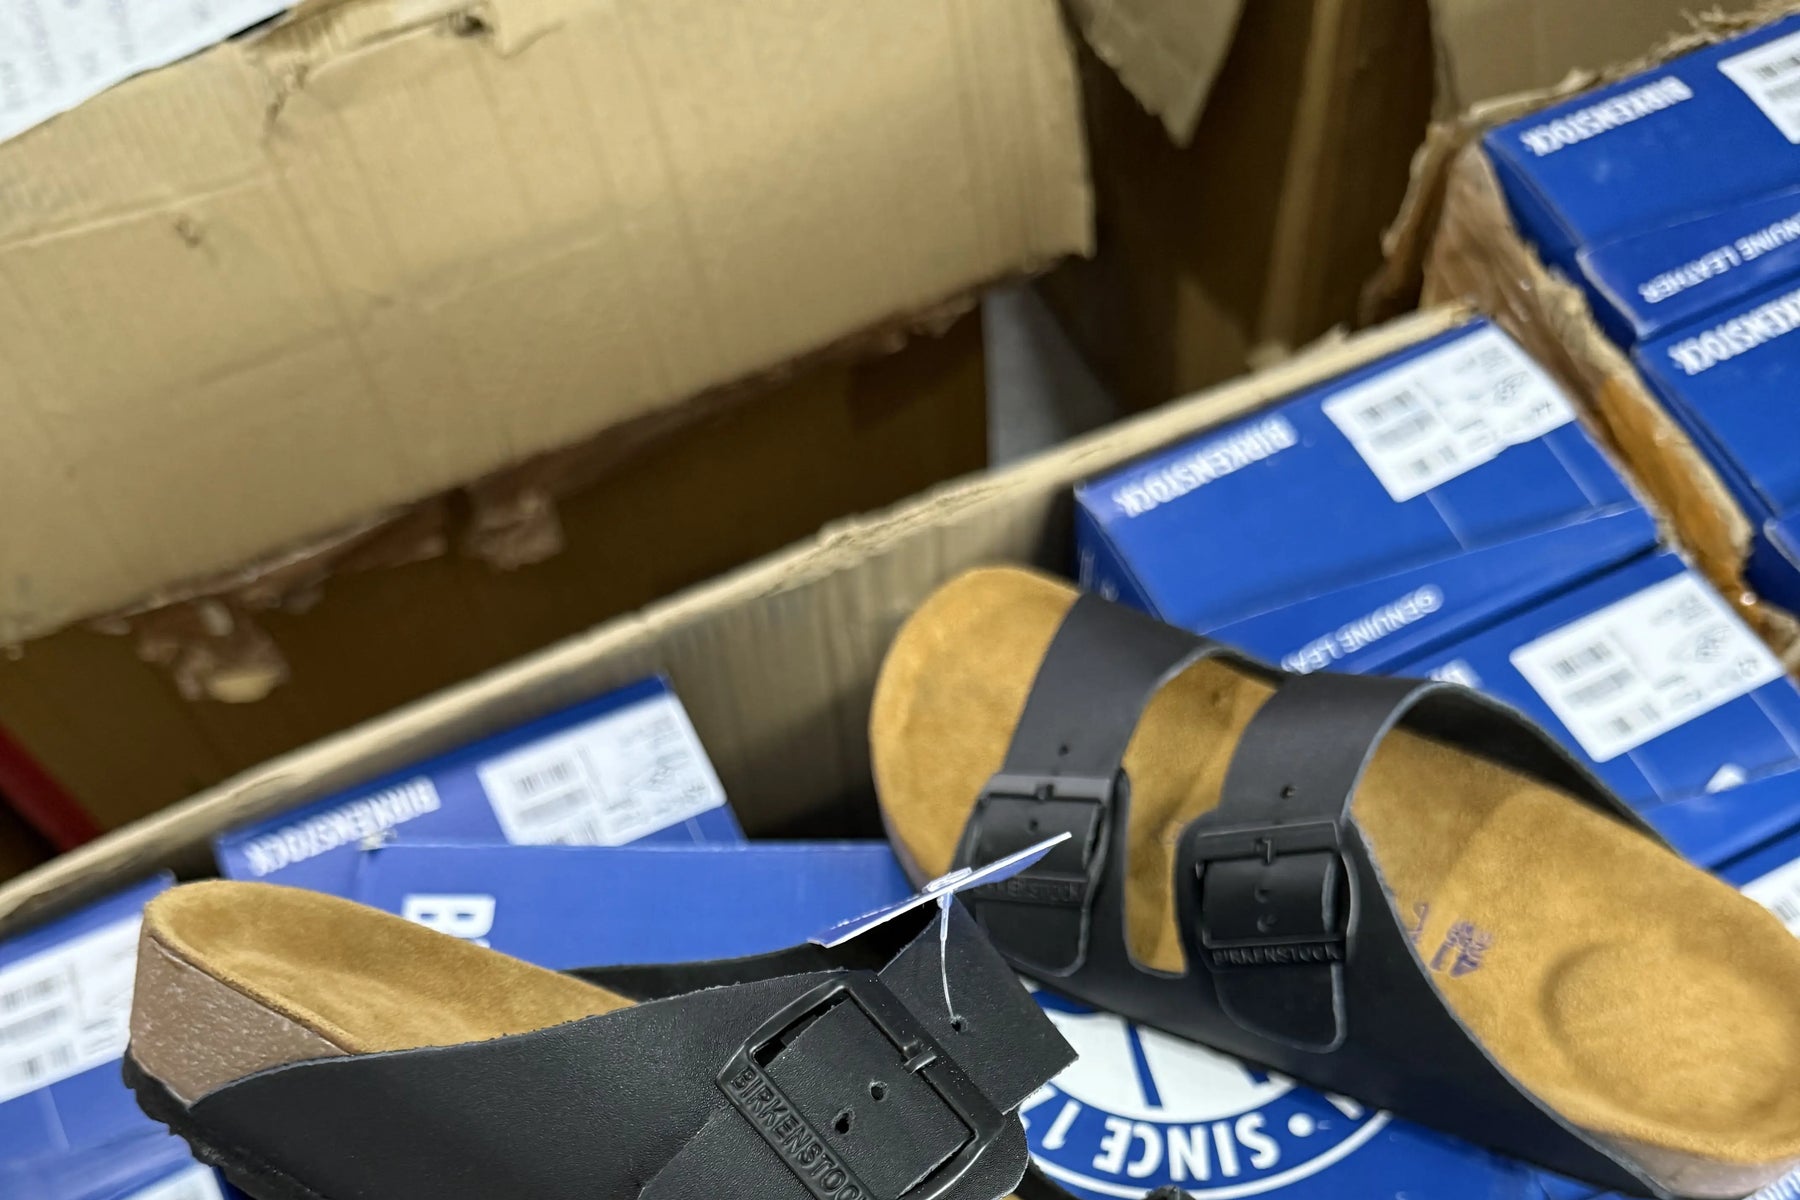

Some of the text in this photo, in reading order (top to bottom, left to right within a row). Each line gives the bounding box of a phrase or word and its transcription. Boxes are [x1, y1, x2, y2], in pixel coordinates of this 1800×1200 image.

[1520, 76, 1694, 156] BIRKENSTOCK
[1639, 246, 1742, 303] LEATHER
[1112, 413, 1298, 518] BIRKENSTOCK
[1335, 584, 1444, 653] GENUINE
[243, 776, 441, 876] BIRKENSTOCK
[1092, 1112, 1281, 1181] SINCE
